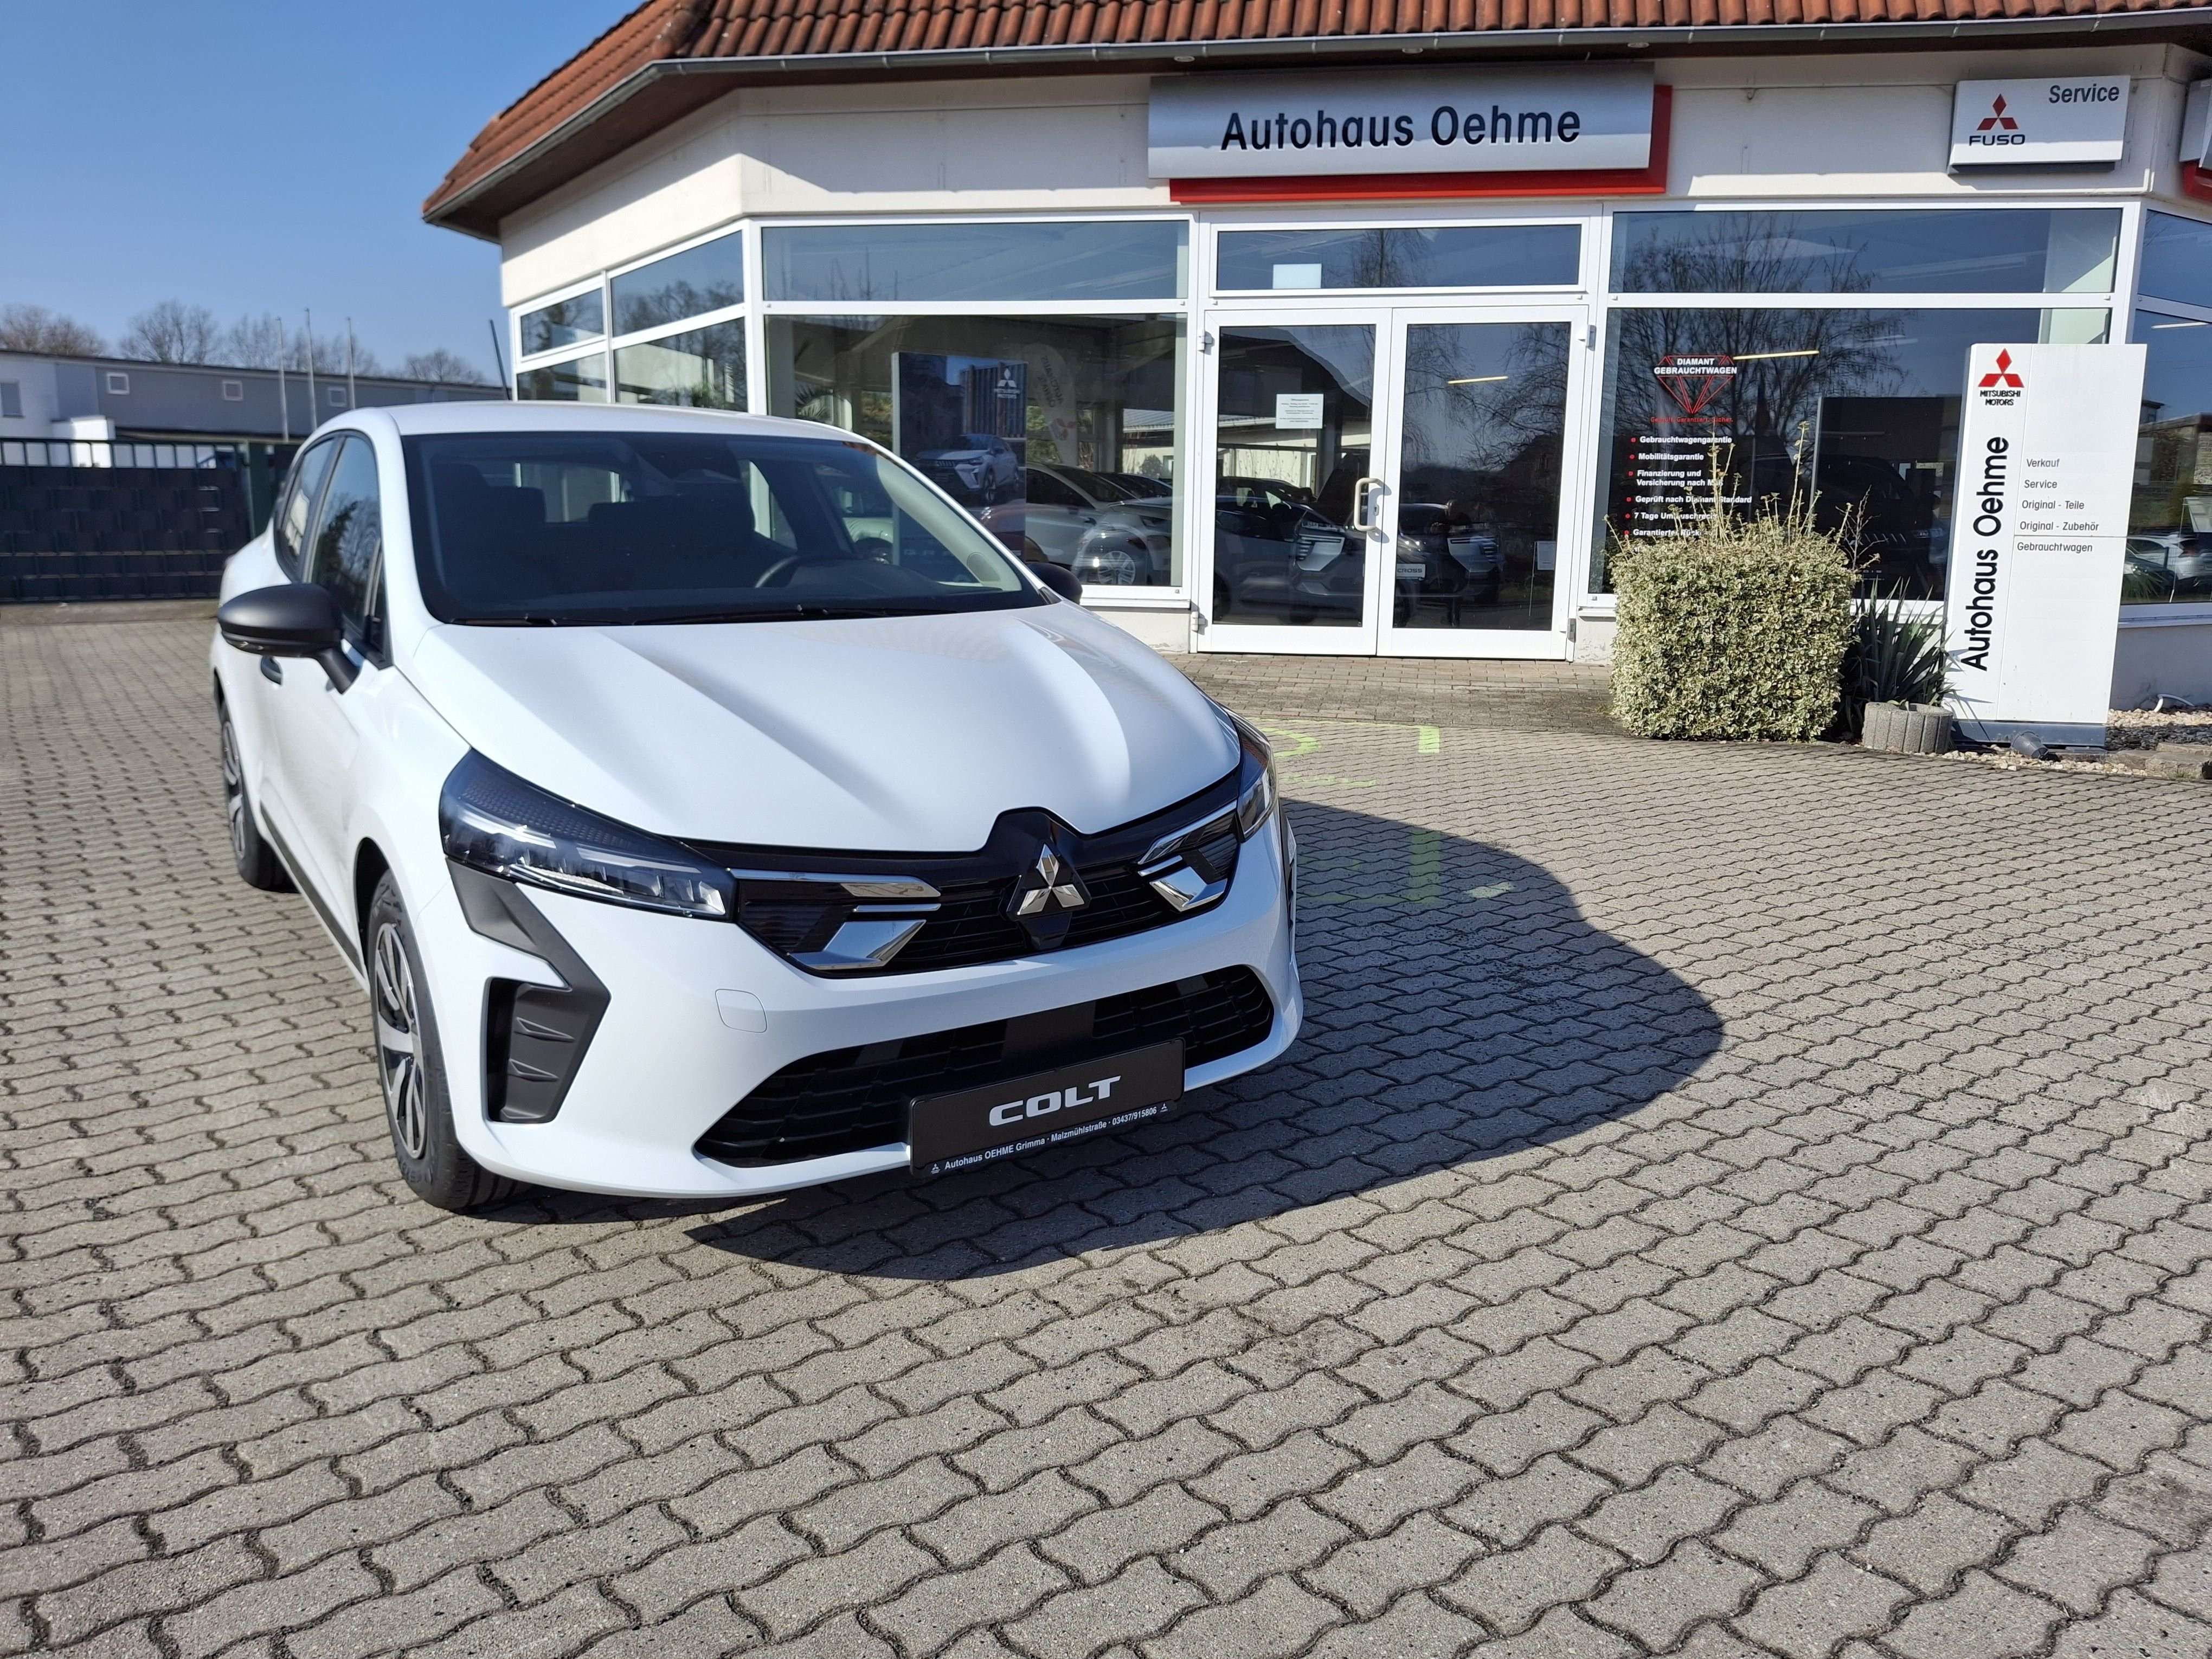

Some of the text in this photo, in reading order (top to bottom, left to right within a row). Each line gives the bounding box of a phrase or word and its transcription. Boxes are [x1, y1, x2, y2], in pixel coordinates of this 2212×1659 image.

[2049, 83, 2120, 104] Service
[1221, 105, 1580, 151] Autohaus Oehme
[1969, 134, 2025, 146] FUSO
[1639, 436, 1732, 444] Gebrauchtwagengarantie
[1638, 453, 1704, 461] Mobilitätsgarantie
[2026, 458, 2060, 467] Verkauf
[2024, 479, 2057, 489] Service
[2022, 500, 2055, 511] Original
[2065, 500, 2085, 510] Teile
[2020, 522, 2054, 532] Original
[2062, 520, 2099, 531] Zubehör
[1960, 436, 2009, 671] Autohaus Oehme
[2017, 542, 2093, 553] Gebrauchtwagen
[989, 1075, 1121, 1126] COLT
[944, 1107, 1157, 1171] Autohaus OEHME Grimma Malzmühlstraße 03437/915806
